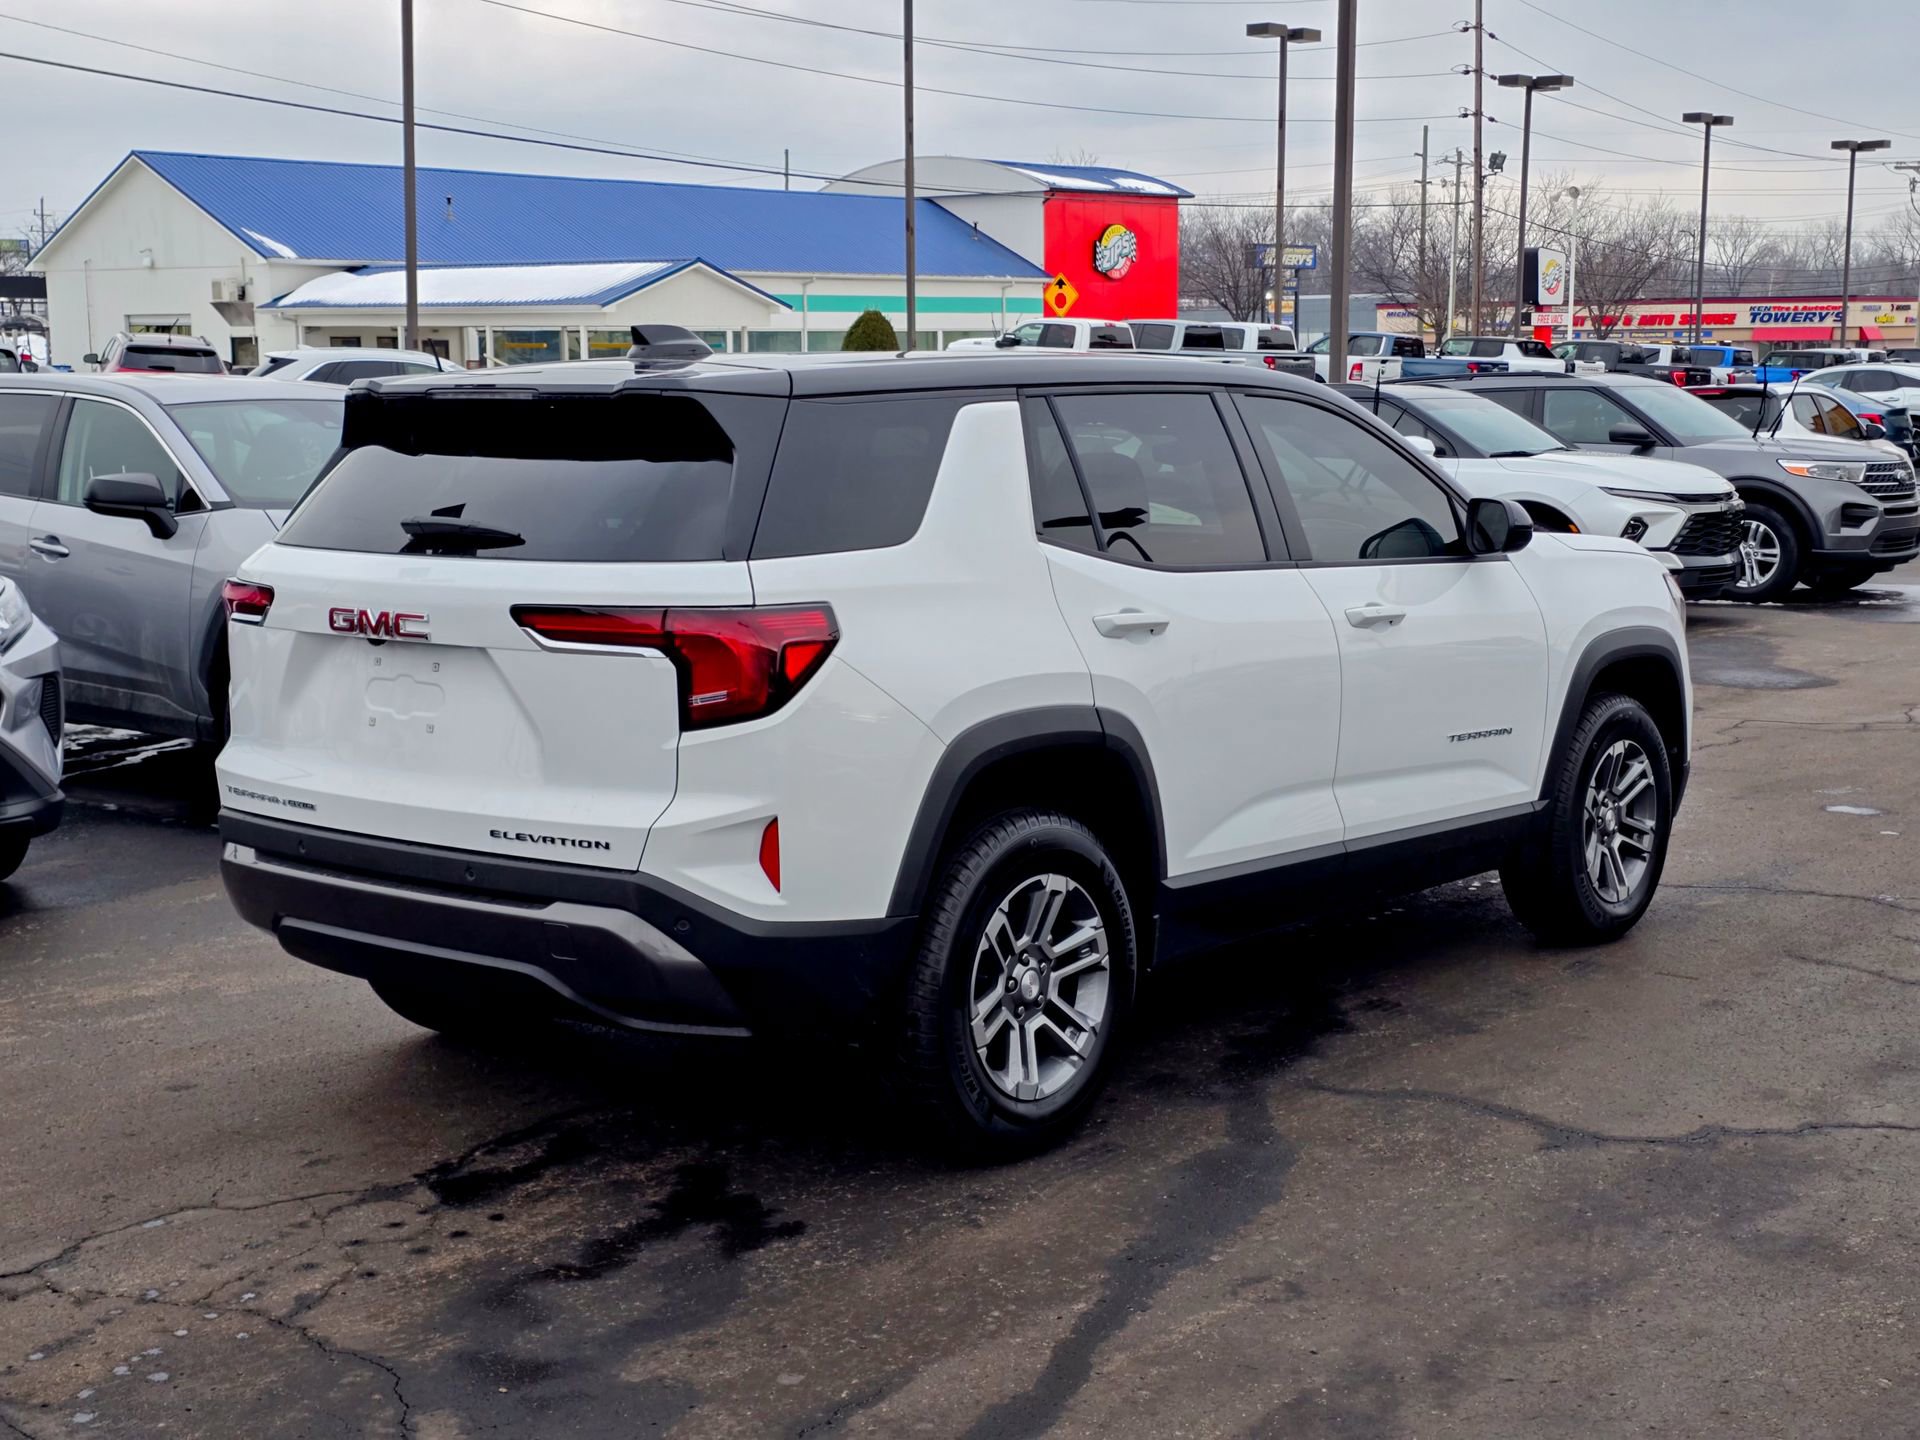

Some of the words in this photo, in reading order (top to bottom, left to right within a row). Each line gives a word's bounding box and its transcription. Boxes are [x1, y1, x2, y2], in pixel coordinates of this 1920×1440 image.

[1102, 233, 1131, 270] ZIPS
[1536, 314, 1550, 324] FREE
[1749, 311, 1844, 324] TOWERY'S
[328, 607, 431, 641] GMC
[1447, 727, 1513, 743] TERRAIN
[489, 829, 611, 850] ELEVATION
